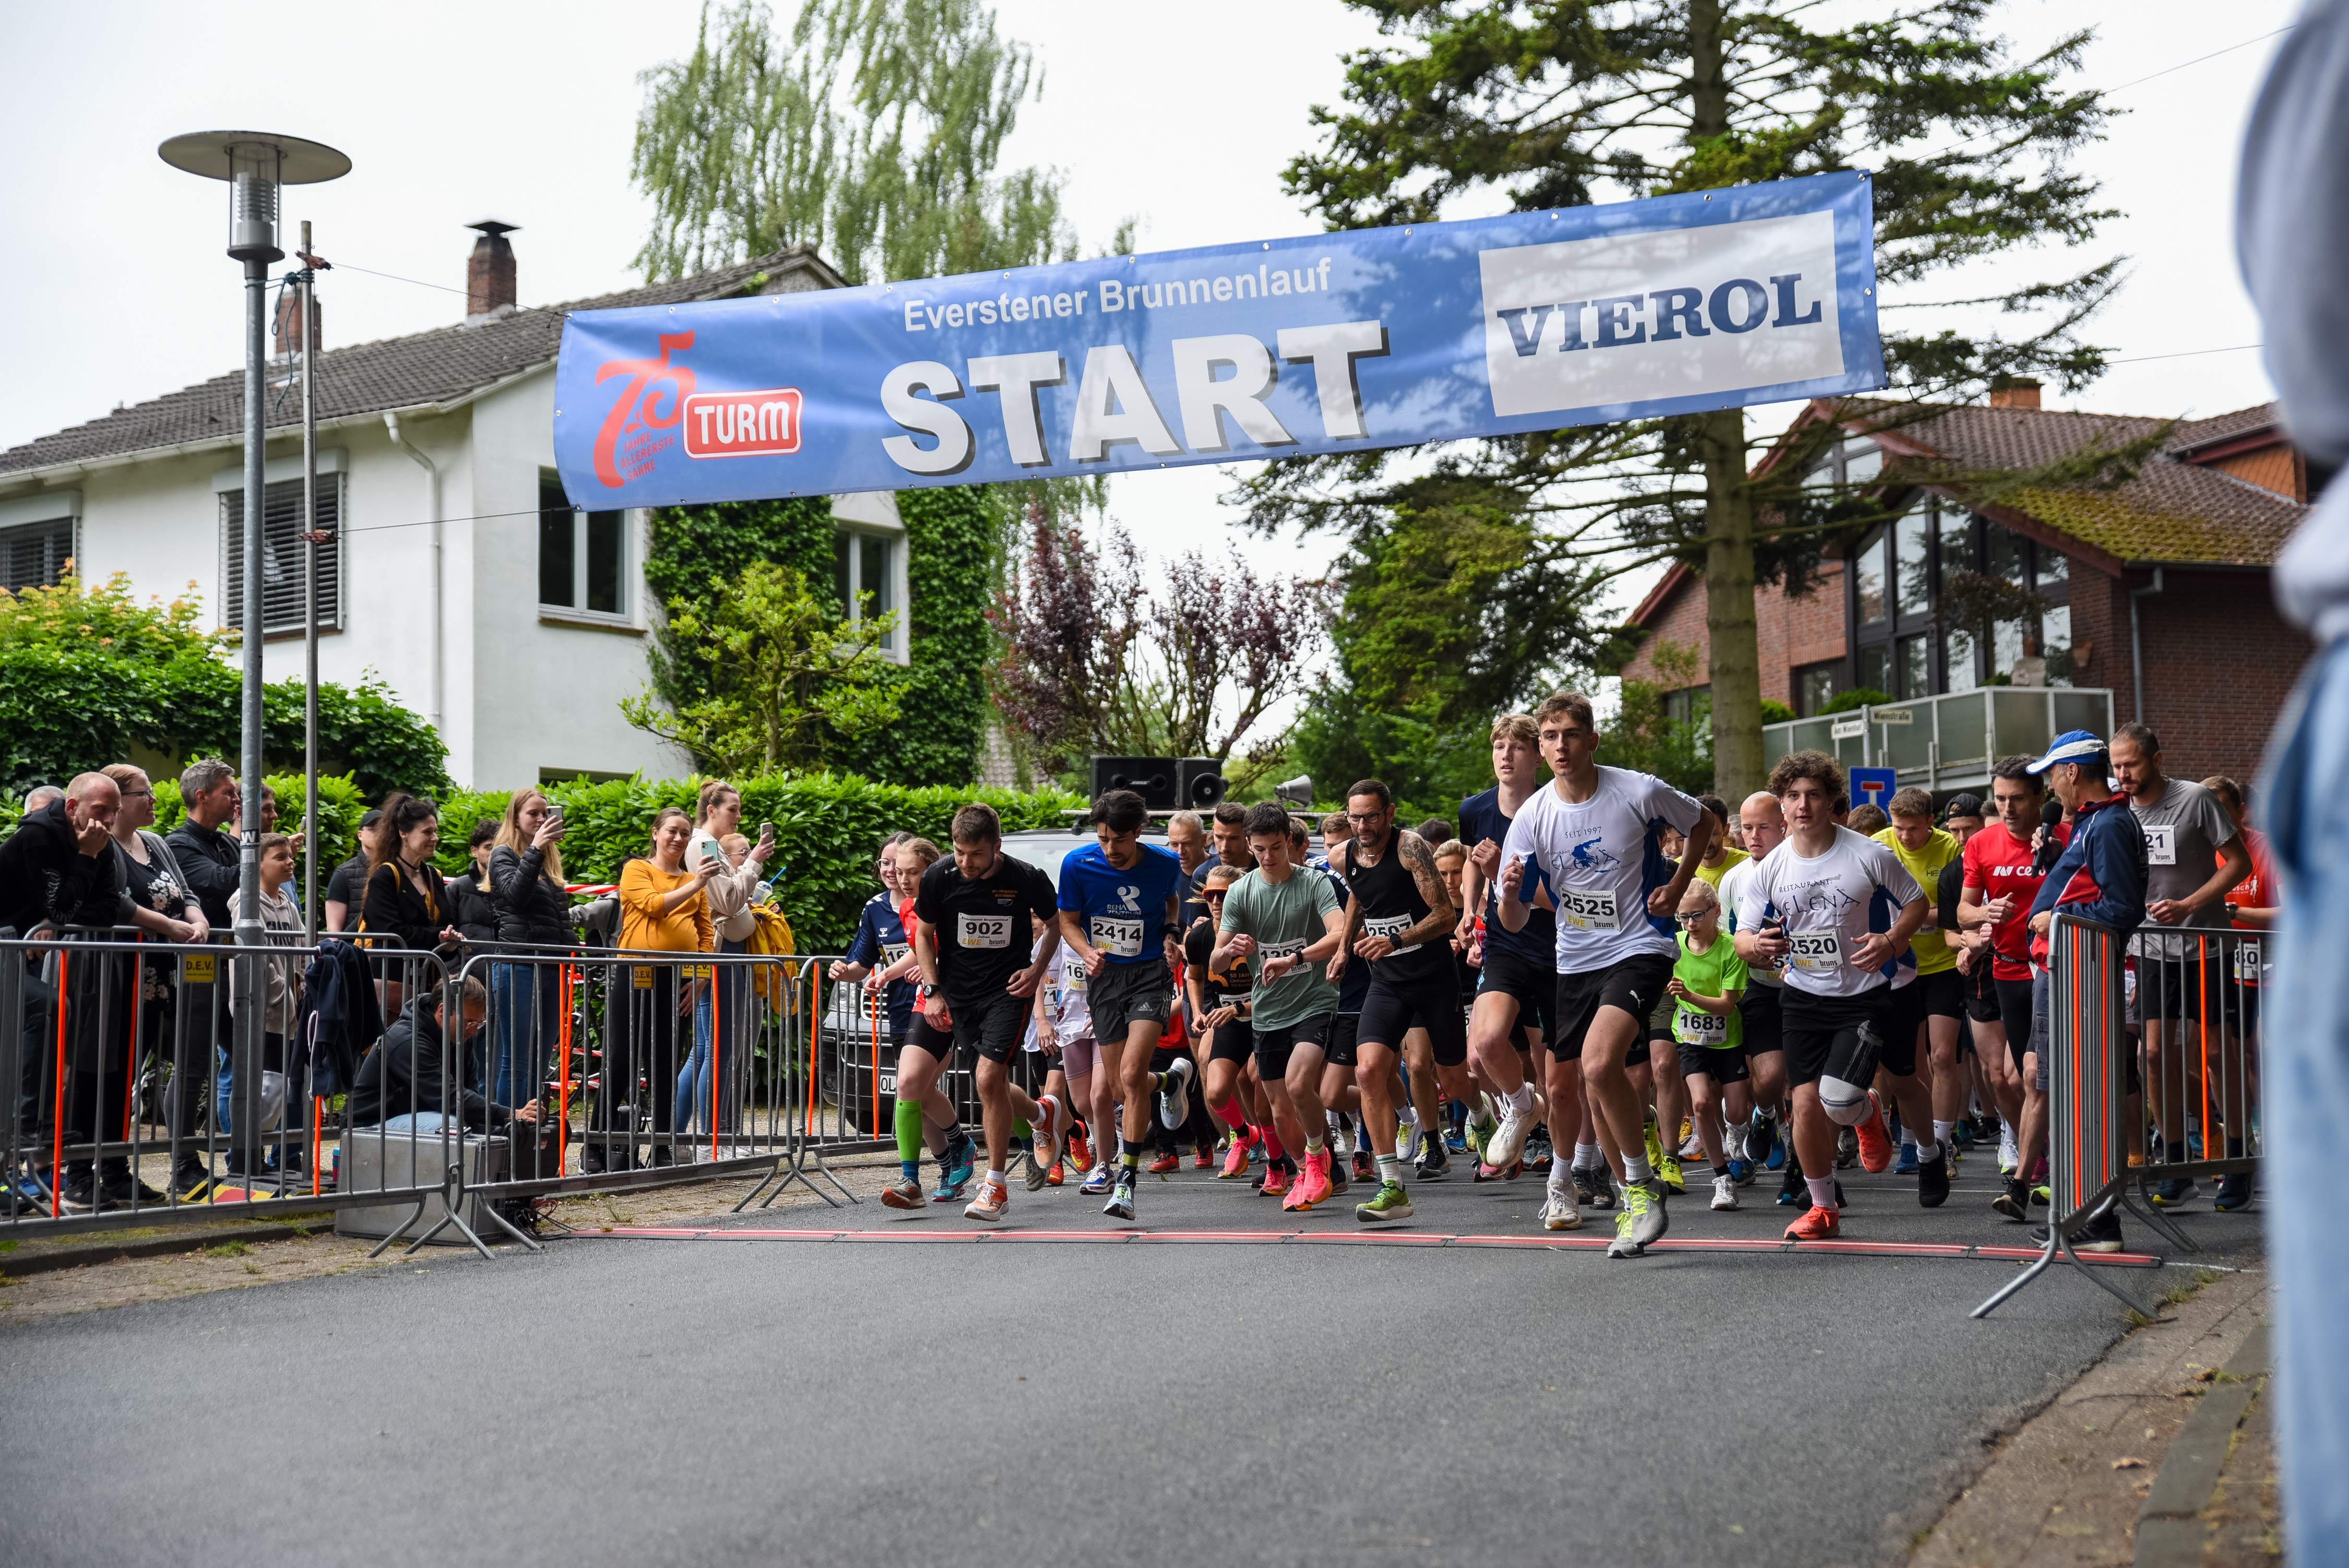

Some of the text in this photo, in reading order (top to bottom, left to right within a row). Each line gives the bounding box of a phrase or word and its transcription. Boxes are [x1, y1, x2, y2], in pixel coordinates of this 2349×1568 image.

[904, 257, 1332, 332] Everstener Brunnenlauf
[1497, 273, 1822, 357] VIEROL
[880, 319, 1390, 476] START
[694, 400, 790, 445] TURM
[624, 431, 651, 453] JAHRE
[621, 434, 674, 469] ALLERERSTE
[627, 459, 656, 481] SAHNE
[1565, 826, 1602, 839] SEIT 1997
[1551, 849, 1621, 870] ELENA
[1561, 888, 1582, 897] Everstener
[1779, 879, 1830, 893] RESTAURANT
[1562, 893, 1615, 917] 2525
[1784, 888, 1861, 916] ELENA
[965, 922, 1003, 935] 902
[1568, 915, 1585, 927] EWE
[1093, 922, 1142, 942] 2414
[1096, 941, 1114, 951] EWE
[1279, 940, 1303, 949] Brunnenlauf
[1789, 938, 1837, 955] 2520
[186, 960, 212, 971] D.E.V.
[1796, 959, 1813, 967] EWE
[634, 970, 651, 979] D.E.V.
[1680, 1014, 1726, 1030] 1683
